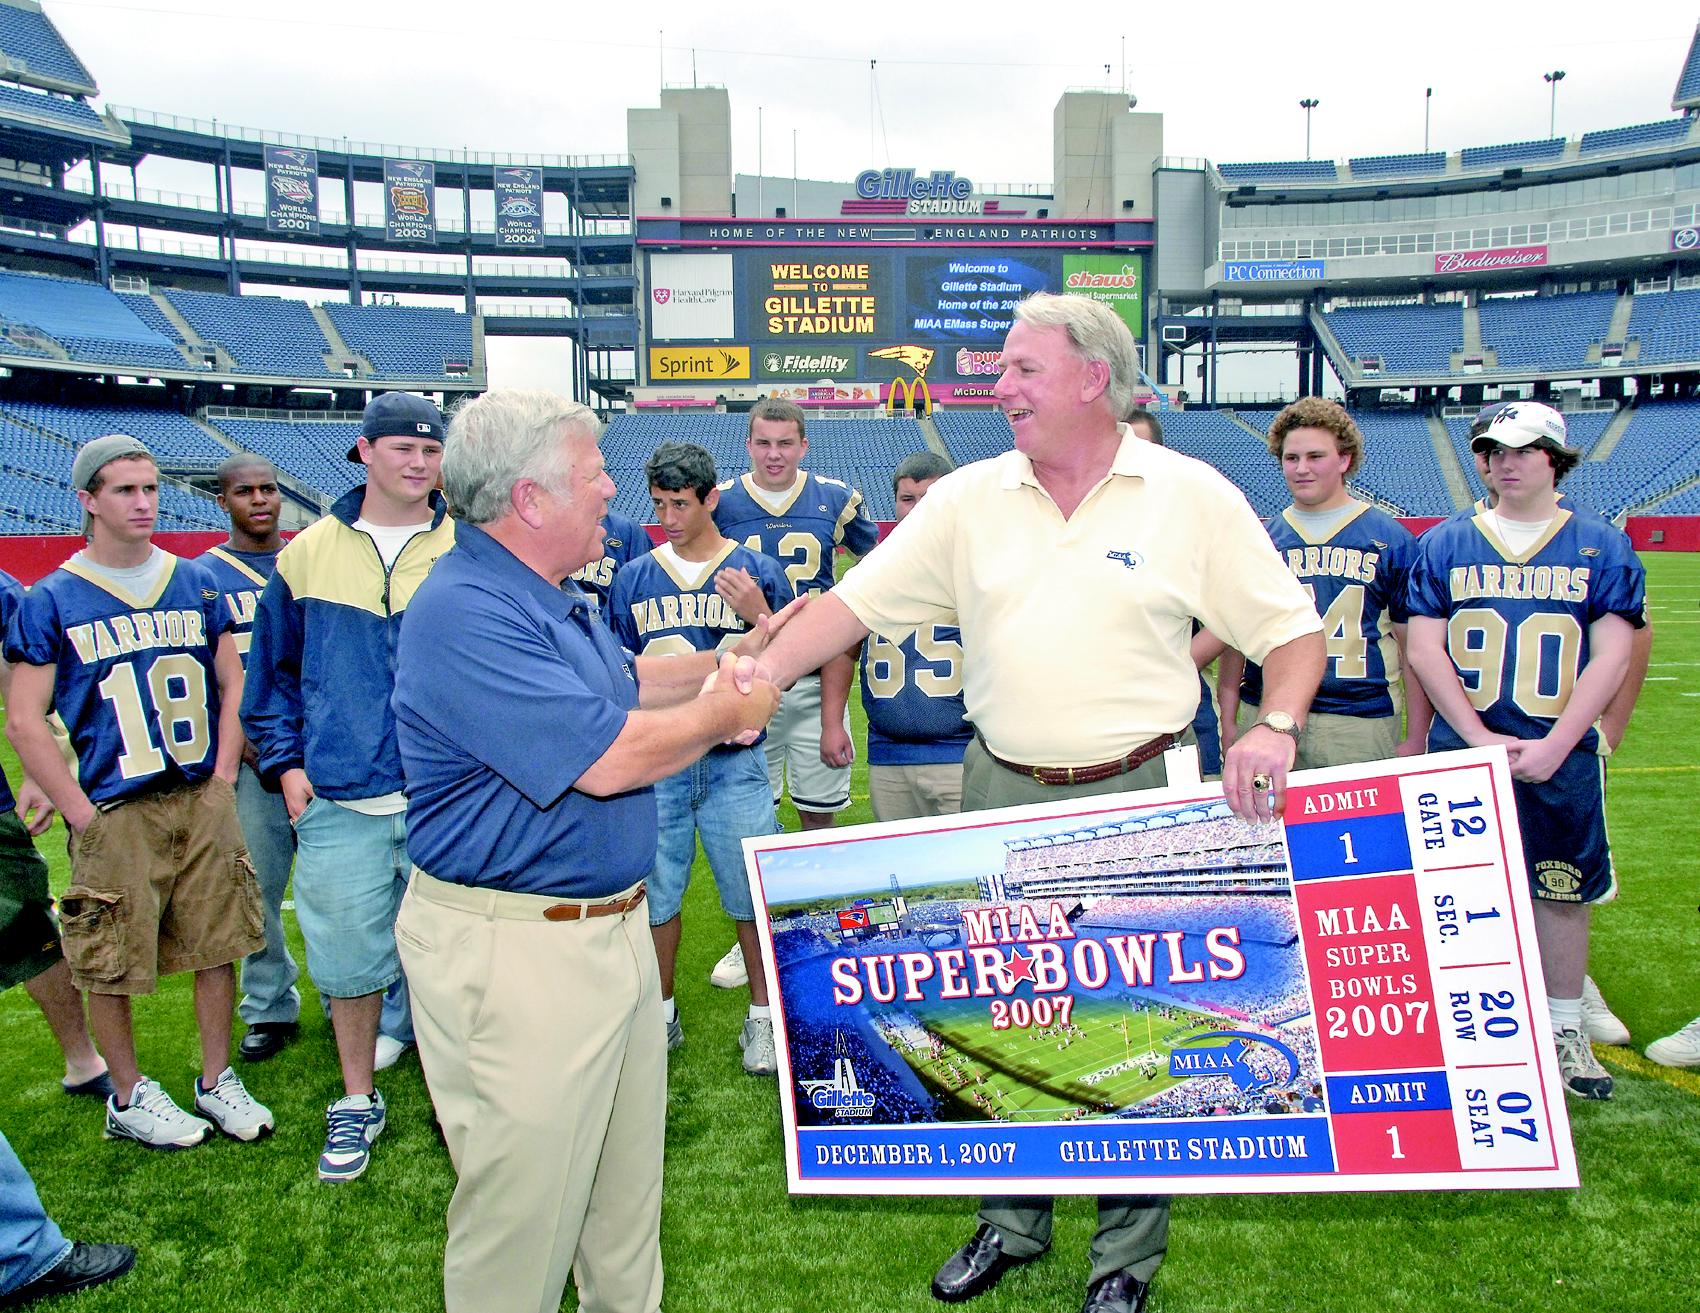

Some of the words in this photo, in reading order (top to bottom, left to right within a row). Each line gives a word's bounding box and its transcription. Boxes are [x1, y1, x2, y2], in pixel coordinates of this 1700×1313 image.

[277, 169, 307, 177] PATRIOTS
[286, 164, 315, 173] ENGLAND
[855, 168, 973, 199] Gillette
[271, 211, 317, 221] CHAMPIONS
[279, 204, 307, 213] WORLD
[910, 200, 981, 214] STADIUM
[278, 219, 310, 230] 2001
[389, 221, 432, 230] CHAMPIONS
[395, 229, 427, 238] 2003
[709, 228, 753, 238] HOME
[766, 228, 785, 238] OF
[796, 228, 825, 238] THE
[838, 228, 871, 238] NEW
[935, 229, 1010, 238] ENGLAND
[1021, 229, 1097, 239] PATRIOTS
[504, 235, 536, 243] 2004
[771, 264, 869, 279] WELCOME
[949, 263, 996, 273] Welcome
[998, 264, 1009, 273] to
[1438, 251, 1544, 272] Budweiser
[1228, 266, 1247, 280] PC
[1249, 265, 1321, 280] Connection
[812, 282, 828, 292] TO
[941, 282, 977, 292] Gillette
[979, 282, 1022, 292] Stadium
[1093, 291, 1138, 301] Supermarket
[764, 297, 875, 314] GILLETTE
[938, 300, 968, 310] Home
[969, 300, 982, 310] of
[983, 300, 999, 310] the
[768, 316, 874, 334] STADIUM
[914, 319, 942, 329] MIAA
[943, 319, 977, 329] EMass
[979, 319, 1011, 331] Super
[660, 356, 714, 377] Sprint
[783, 355, 847, 372] Fidelity
[1281, 546, 1379, 583] RRIORS
[1449, 565, 1590, 603] WARRIORS
[631, 593, 744, 636] WARRIOR
[67, 611, 206, 664] WARRIOR
[1448, 608, 1582, 718] 90
[99, 653, 211, 779] 18
[1304, 788, 1379, 815] ADMIT
[1418, 793, 1446, 850] GATE
[1448, 796, 1487, 838] 12
[1338, 832, 1358, 864] 1
[1535, 860, 1582, 879] FOXBORO
[1551, 877, 1565, 888] 90
[1537, 889, 1582, 901] WARRIORS
[961, 902, 1075, 945] MIAA
[1314, 903, 1410, 937] MIAA
[1434, 895, 1459, 944] SEC.
[1465, 907, 1501, 924] 1
[830, 945, 1014, 1006] SUPER
[1026, 925, 1247, 993] BOWLS
[1326, 942, 1411, 968] SUPER
[1328, 974, 1417, 999] BOWLS
[991, 995, 1074, 1030] 2007
[1326, 1001, 1429, 1039] 2007
[1449, 990, 1477, 1041] ROW
[1479, 990, 1519, 1038] 20
[1173, 1052, 1234, 1070] MIAA
[813, 1089, 875, 1108] Gillette
[1350, 1082, 1427, 1104] ADMIT
[835, 1107, 873, 1117] STADIUM
[1466, 1089, 1494, 1147] SEAT
[1497, 1092, 1538, 1142] 07
[1060, 1140, 1180, 1163] GILLETTE
[1187, 1136, 1307, 1161] STADIUM
[1386, 1126, 1406, 1159] 1
[815, 1144, 930, 1166] DECEMBER
